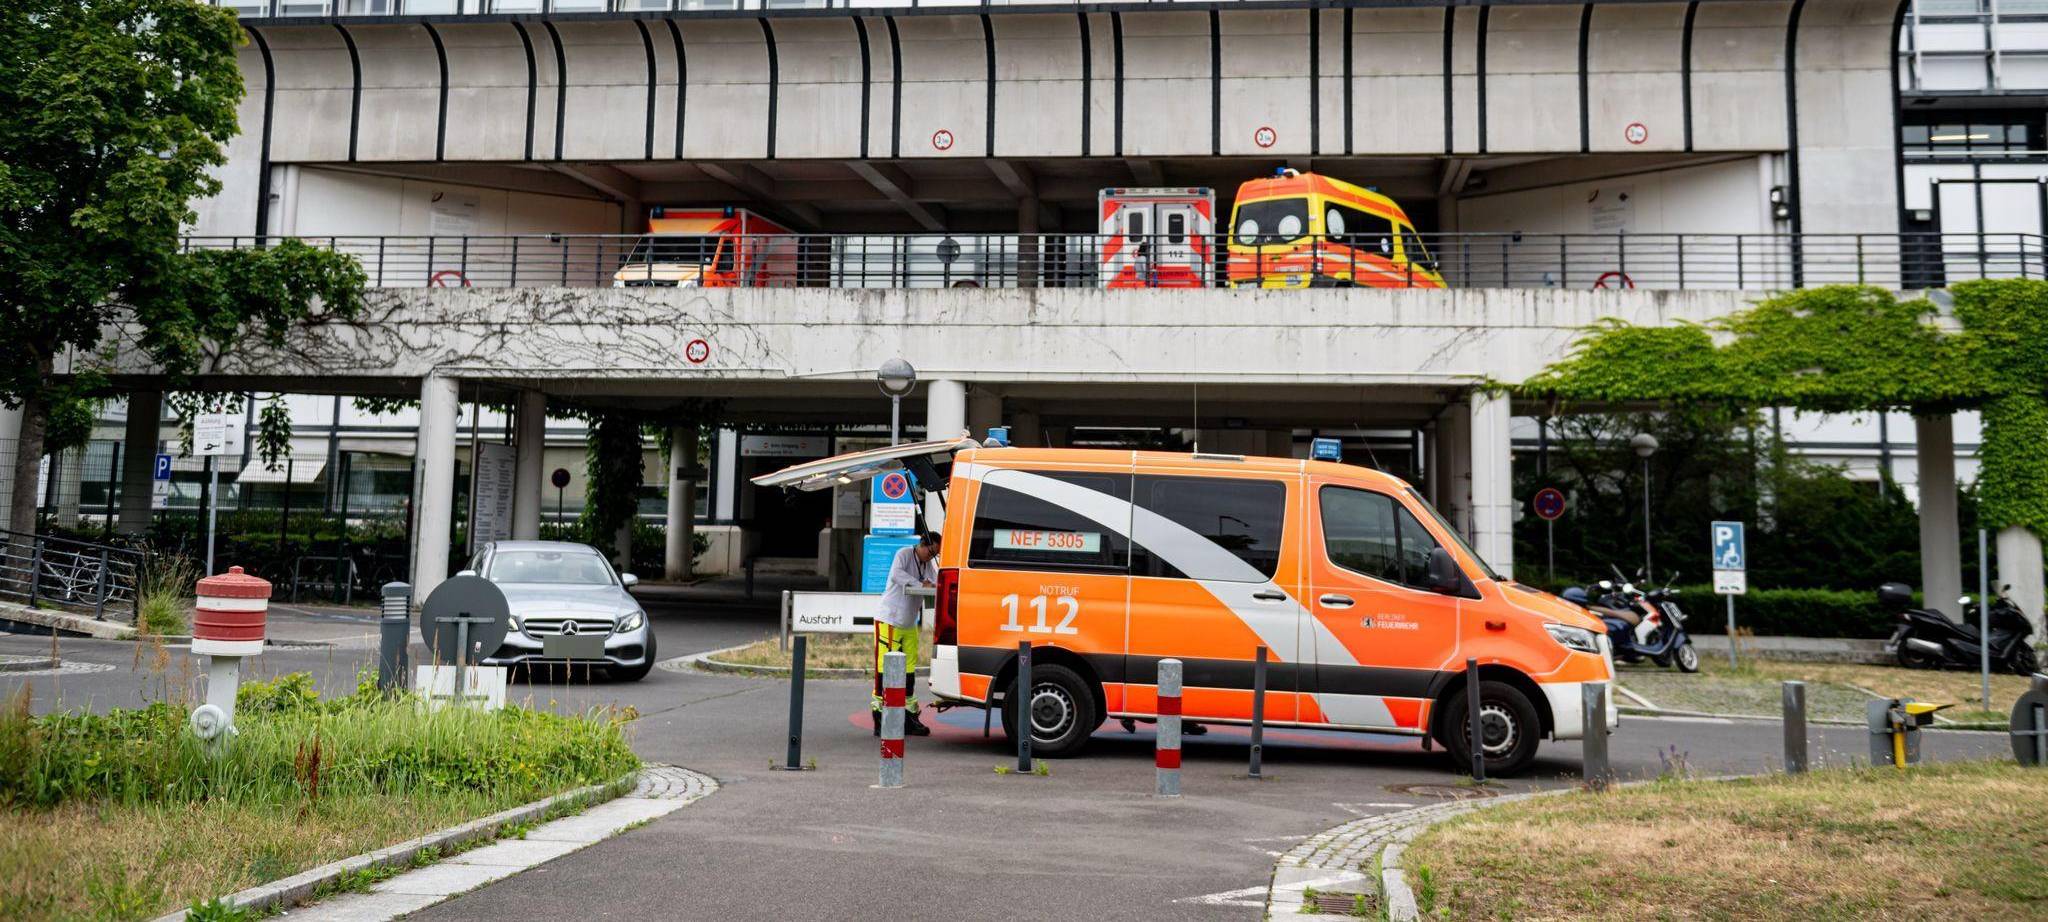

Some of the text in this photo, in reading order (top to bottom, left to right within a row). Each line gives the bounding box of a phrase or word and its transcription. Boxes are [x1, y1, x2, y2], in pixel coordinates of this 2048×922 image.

[1168, 250, 1183, 258] 112
[158, 458, 168, 477] P
[1010, 529, 1084, 549] NEF 5305
[1715, 526, 1734, 547] P
[1039, 584, 1080, 596] NOTRUF
[799, 614, 842, 625] Ausfahrt
[1000, 593, 1080, 635] 112
[1377, 621, 1418, 630] FEUERWEHR
